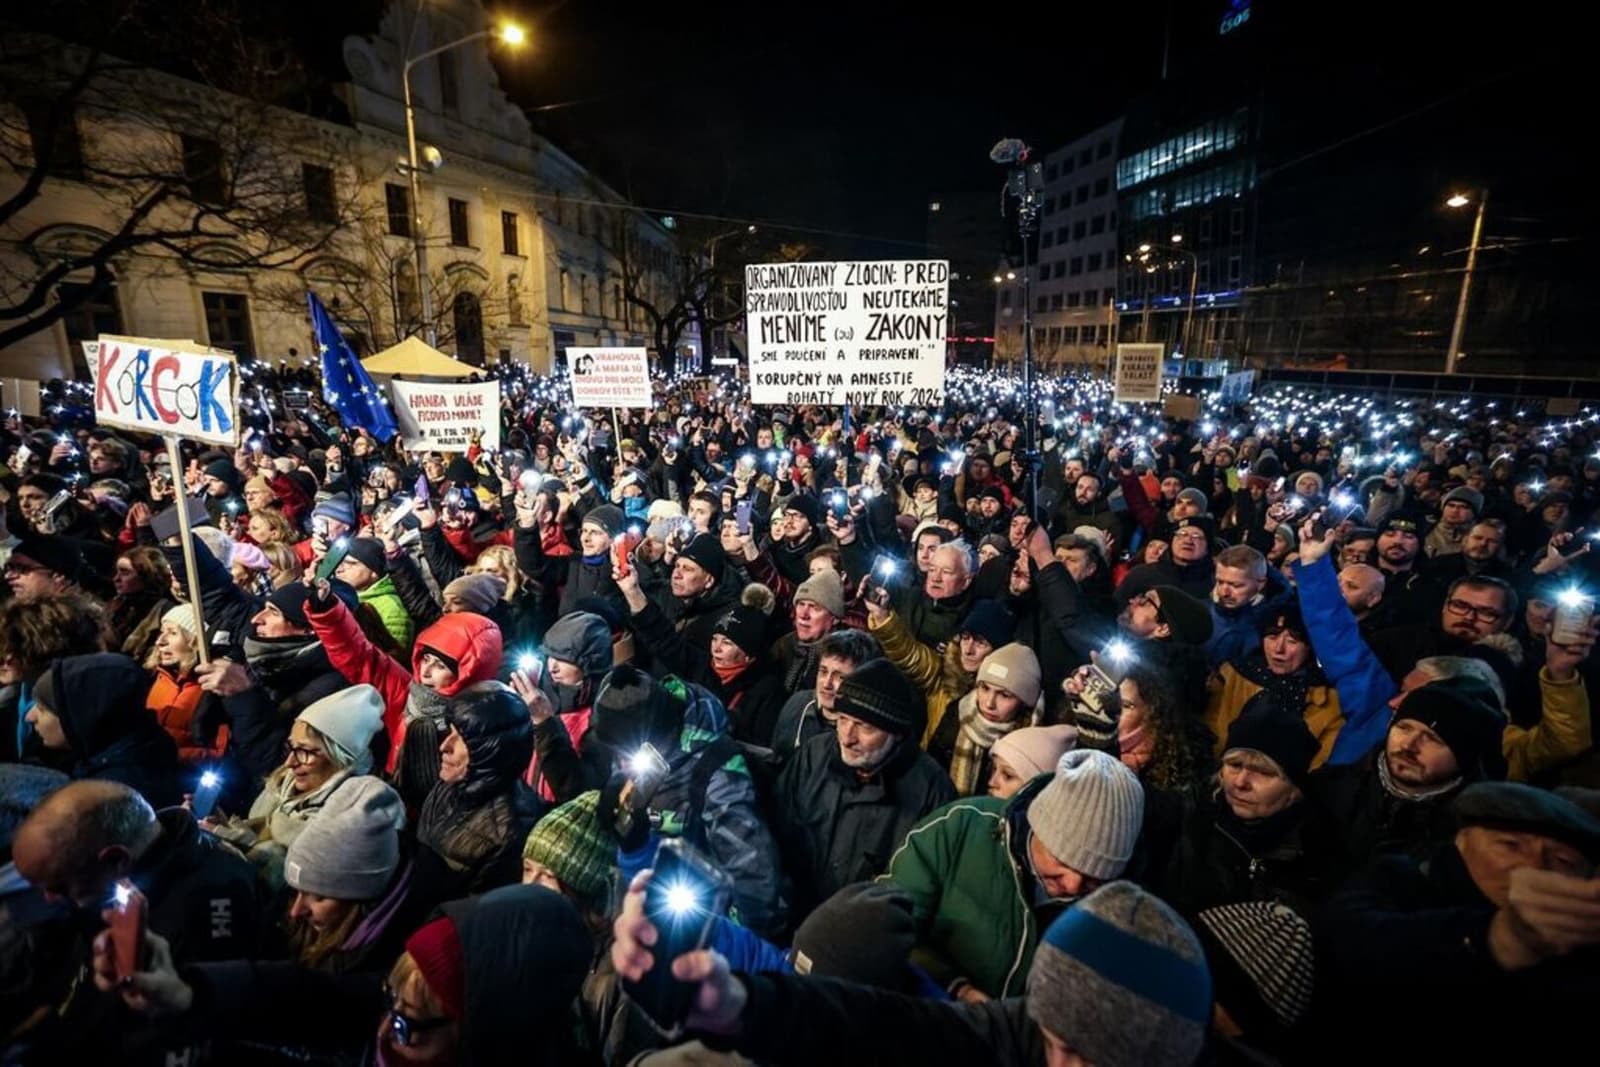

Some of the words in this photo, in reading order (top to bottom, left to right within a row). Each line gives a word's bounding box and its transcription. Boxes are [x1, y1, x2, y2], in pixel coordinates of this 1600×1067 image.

[904, 263, 947, 285] PRED
[760, 312, 827, 344] MENÍME
[837, 350, 846, 360] A
[602, 365, 630, 373] MAFIA
[621, 376, 644, 384] MOCI
[756, 371, 822, 386] KORUPČNÝ
[827, 374, 843, 385] NA
[851, 372, 913, 385] AMNESTIE
[409, 394, 448, 408] HANBA
[454, 392, 484, 407] VLÁDE
[845, 387, 878, 405] NOVÝ
[881, 391, 904, 404] ROK
[910, 388, 942, 405] 2024
